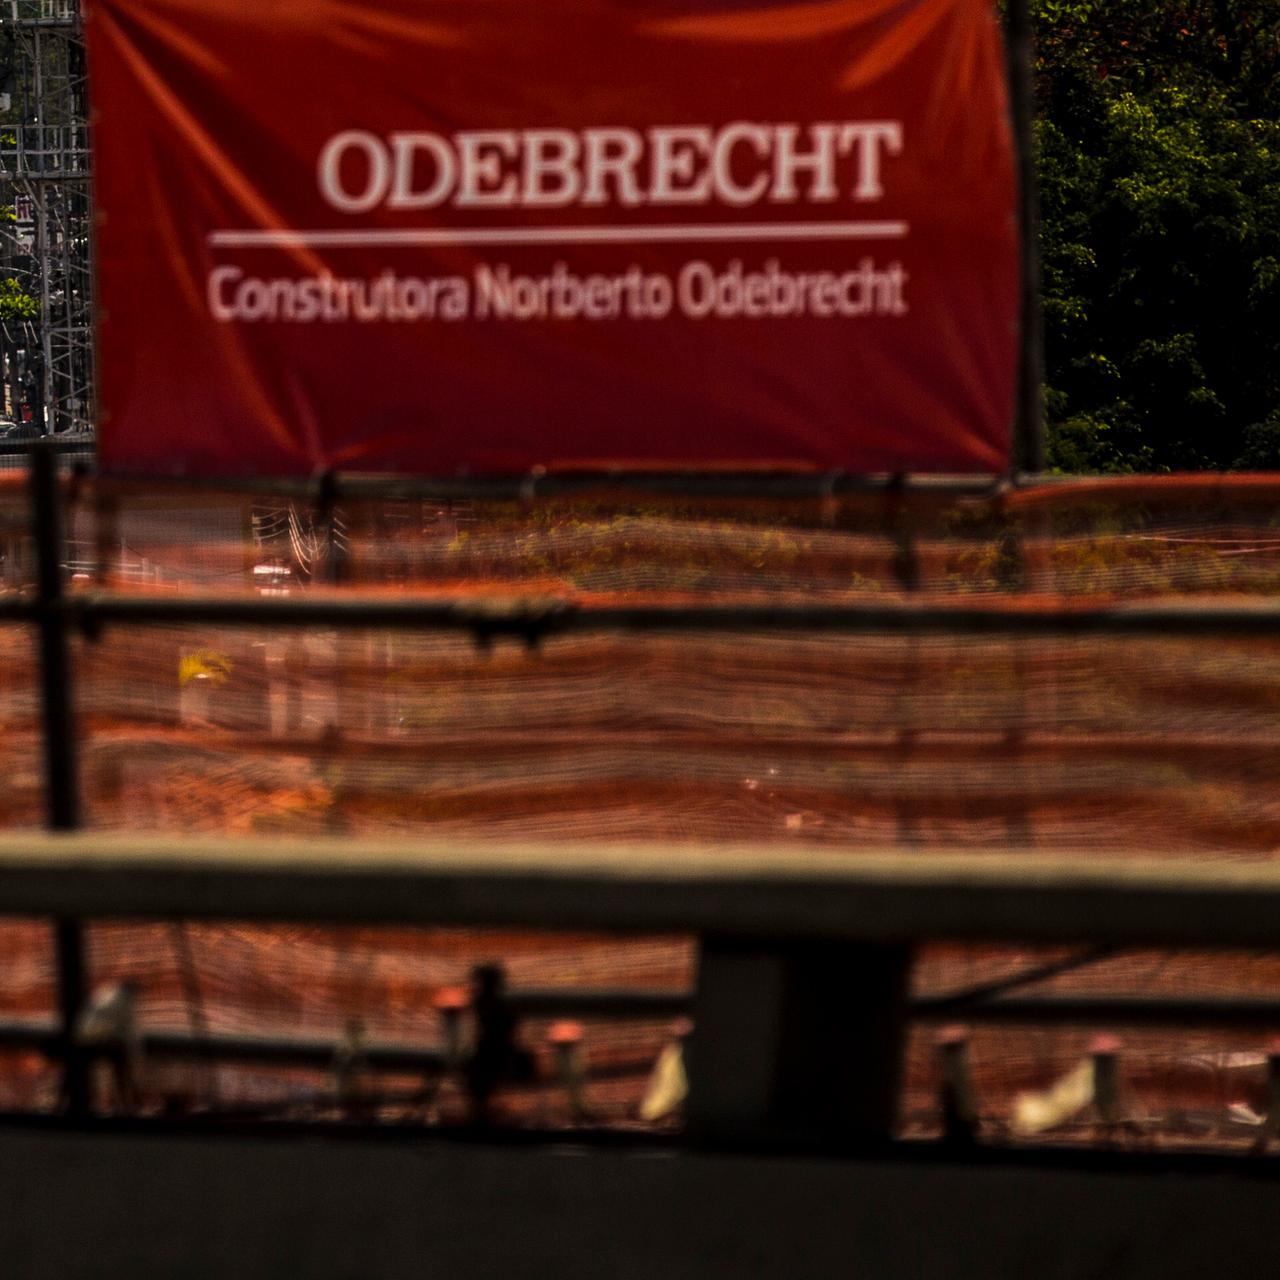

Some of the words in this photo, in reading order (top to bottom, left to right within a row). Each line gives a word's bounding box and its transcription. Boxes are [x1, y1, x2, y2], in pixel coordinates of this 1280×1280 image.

[318, 120, 903, 212] ODEBRECHT
[208, 264, 470, 321] Construtora
[474, 261, 673, 320] Norberto
[677, 257, 906, 317] Odebrecht
